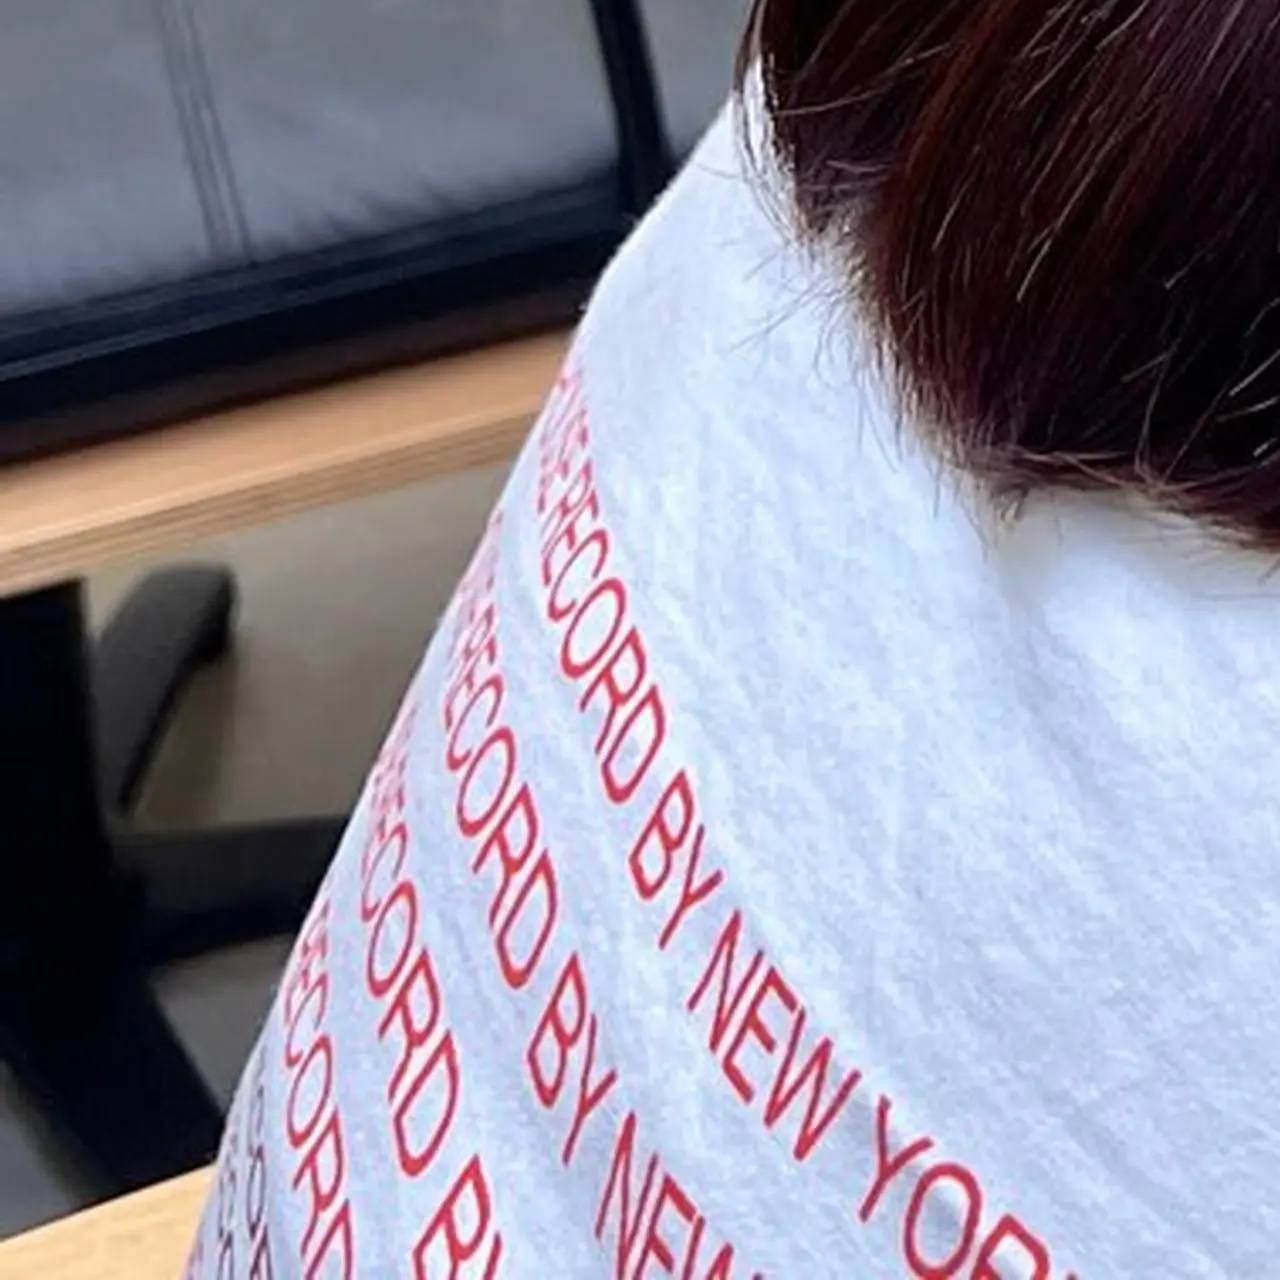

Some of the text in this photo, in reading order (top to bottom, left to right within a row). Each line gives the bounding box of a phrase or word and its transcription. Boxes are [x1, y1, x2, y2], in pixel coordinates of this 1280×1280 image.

[527, 956, 618, 1166] BY
[628, 770, 723, 948] BY
[687, 911, 861, 1161] NEW
[859, 1093, 1078, 1280] YOR
[412, 1153, 502, 1280] B
